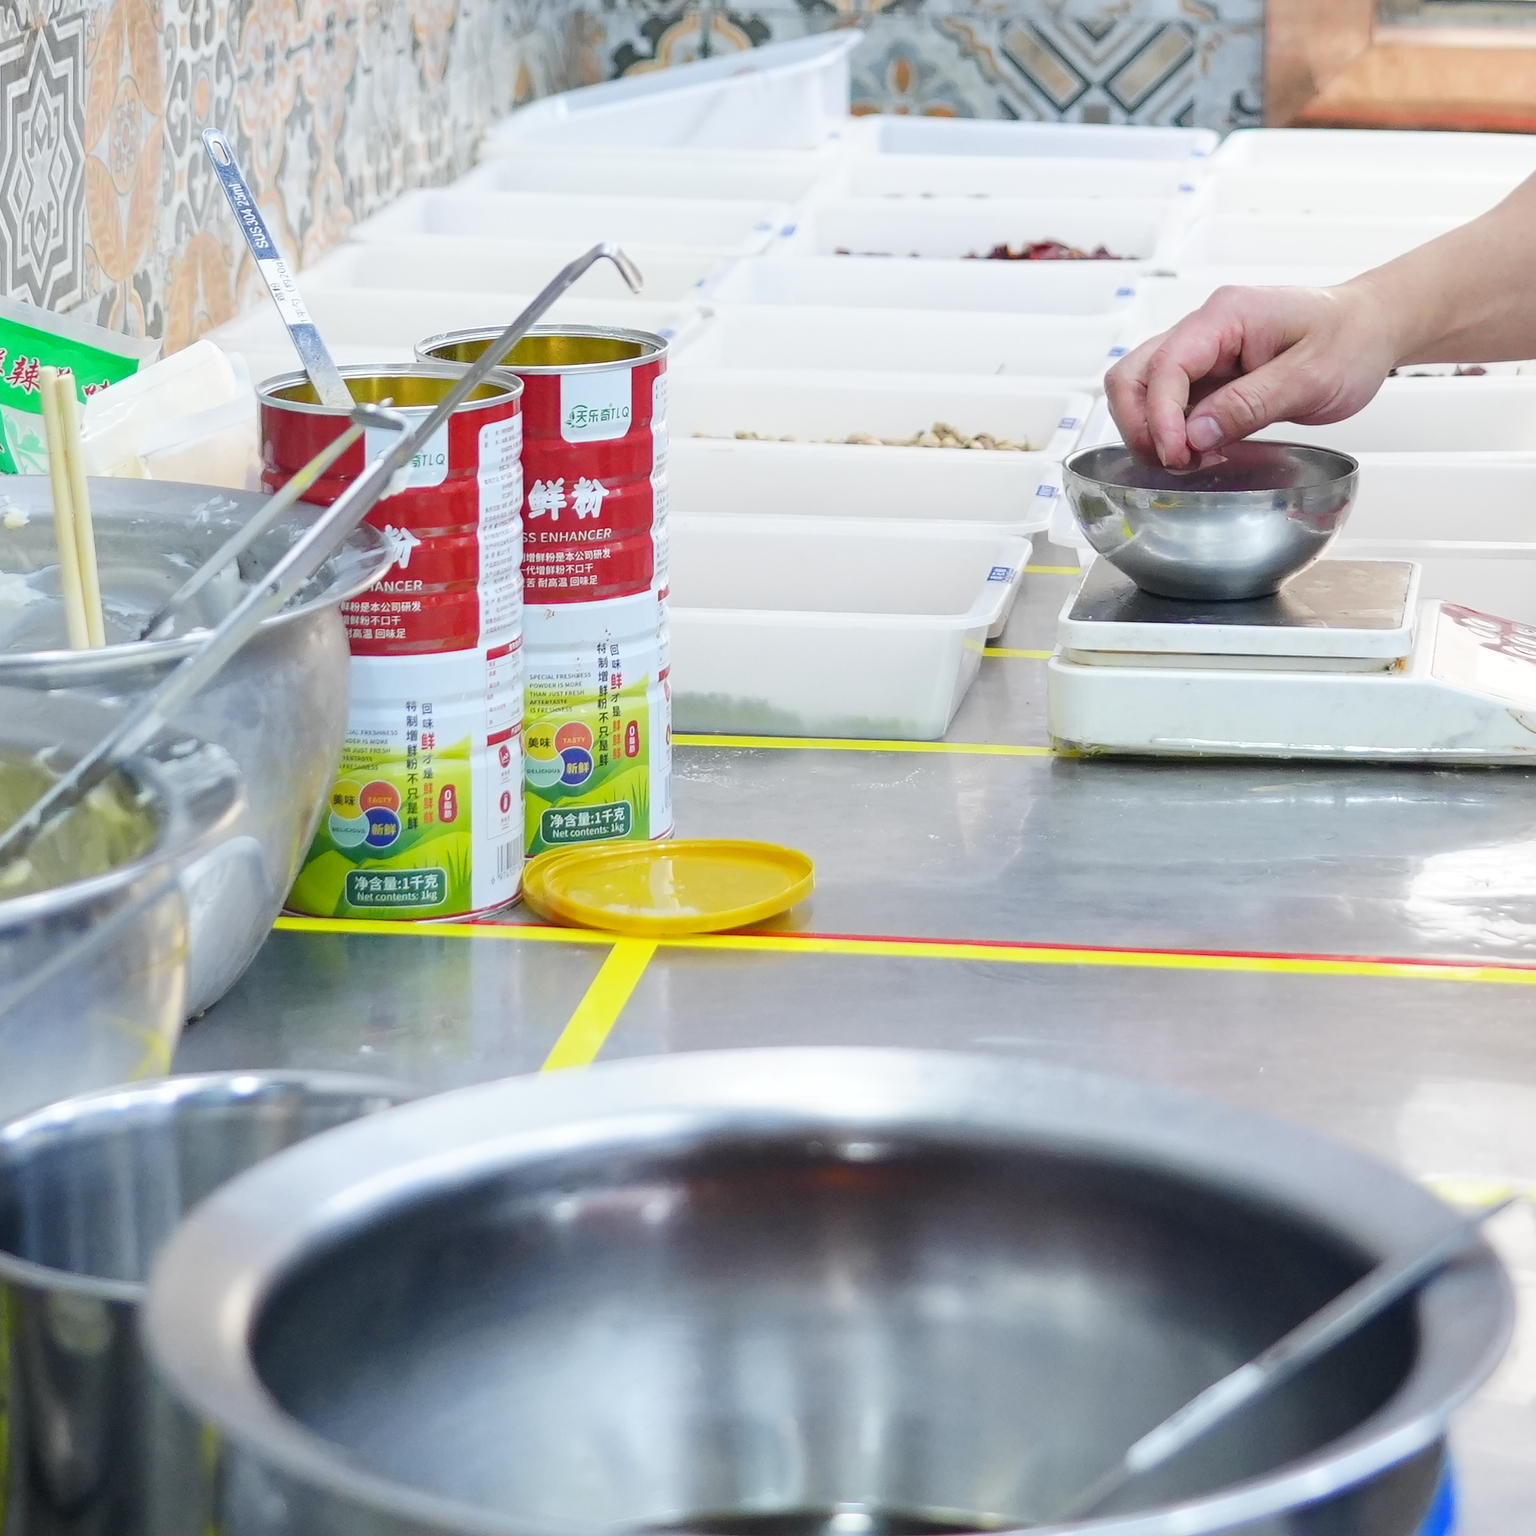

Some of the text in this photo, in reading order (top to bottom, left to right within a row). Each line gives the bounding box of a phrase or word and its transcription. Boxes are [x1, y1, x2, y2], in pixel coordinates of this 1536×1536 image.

[528, 476, 610, 521] 鲜粉
[541, 528, 612, 543] ENHANCER
[365, 580, 423, 592] HANCER
[570, 575, 598, 587] 回味足
[375, 628, 406, 639] 回味足
[528, 737, 551, 748] 美味
[563, 736, 586, 744] TASTY
[368, 796, 393, 804] TASTY
[552, 822, 625, 838] Net contents: 1kg
[356, 890, 438, 902] Net contents: 1kg
